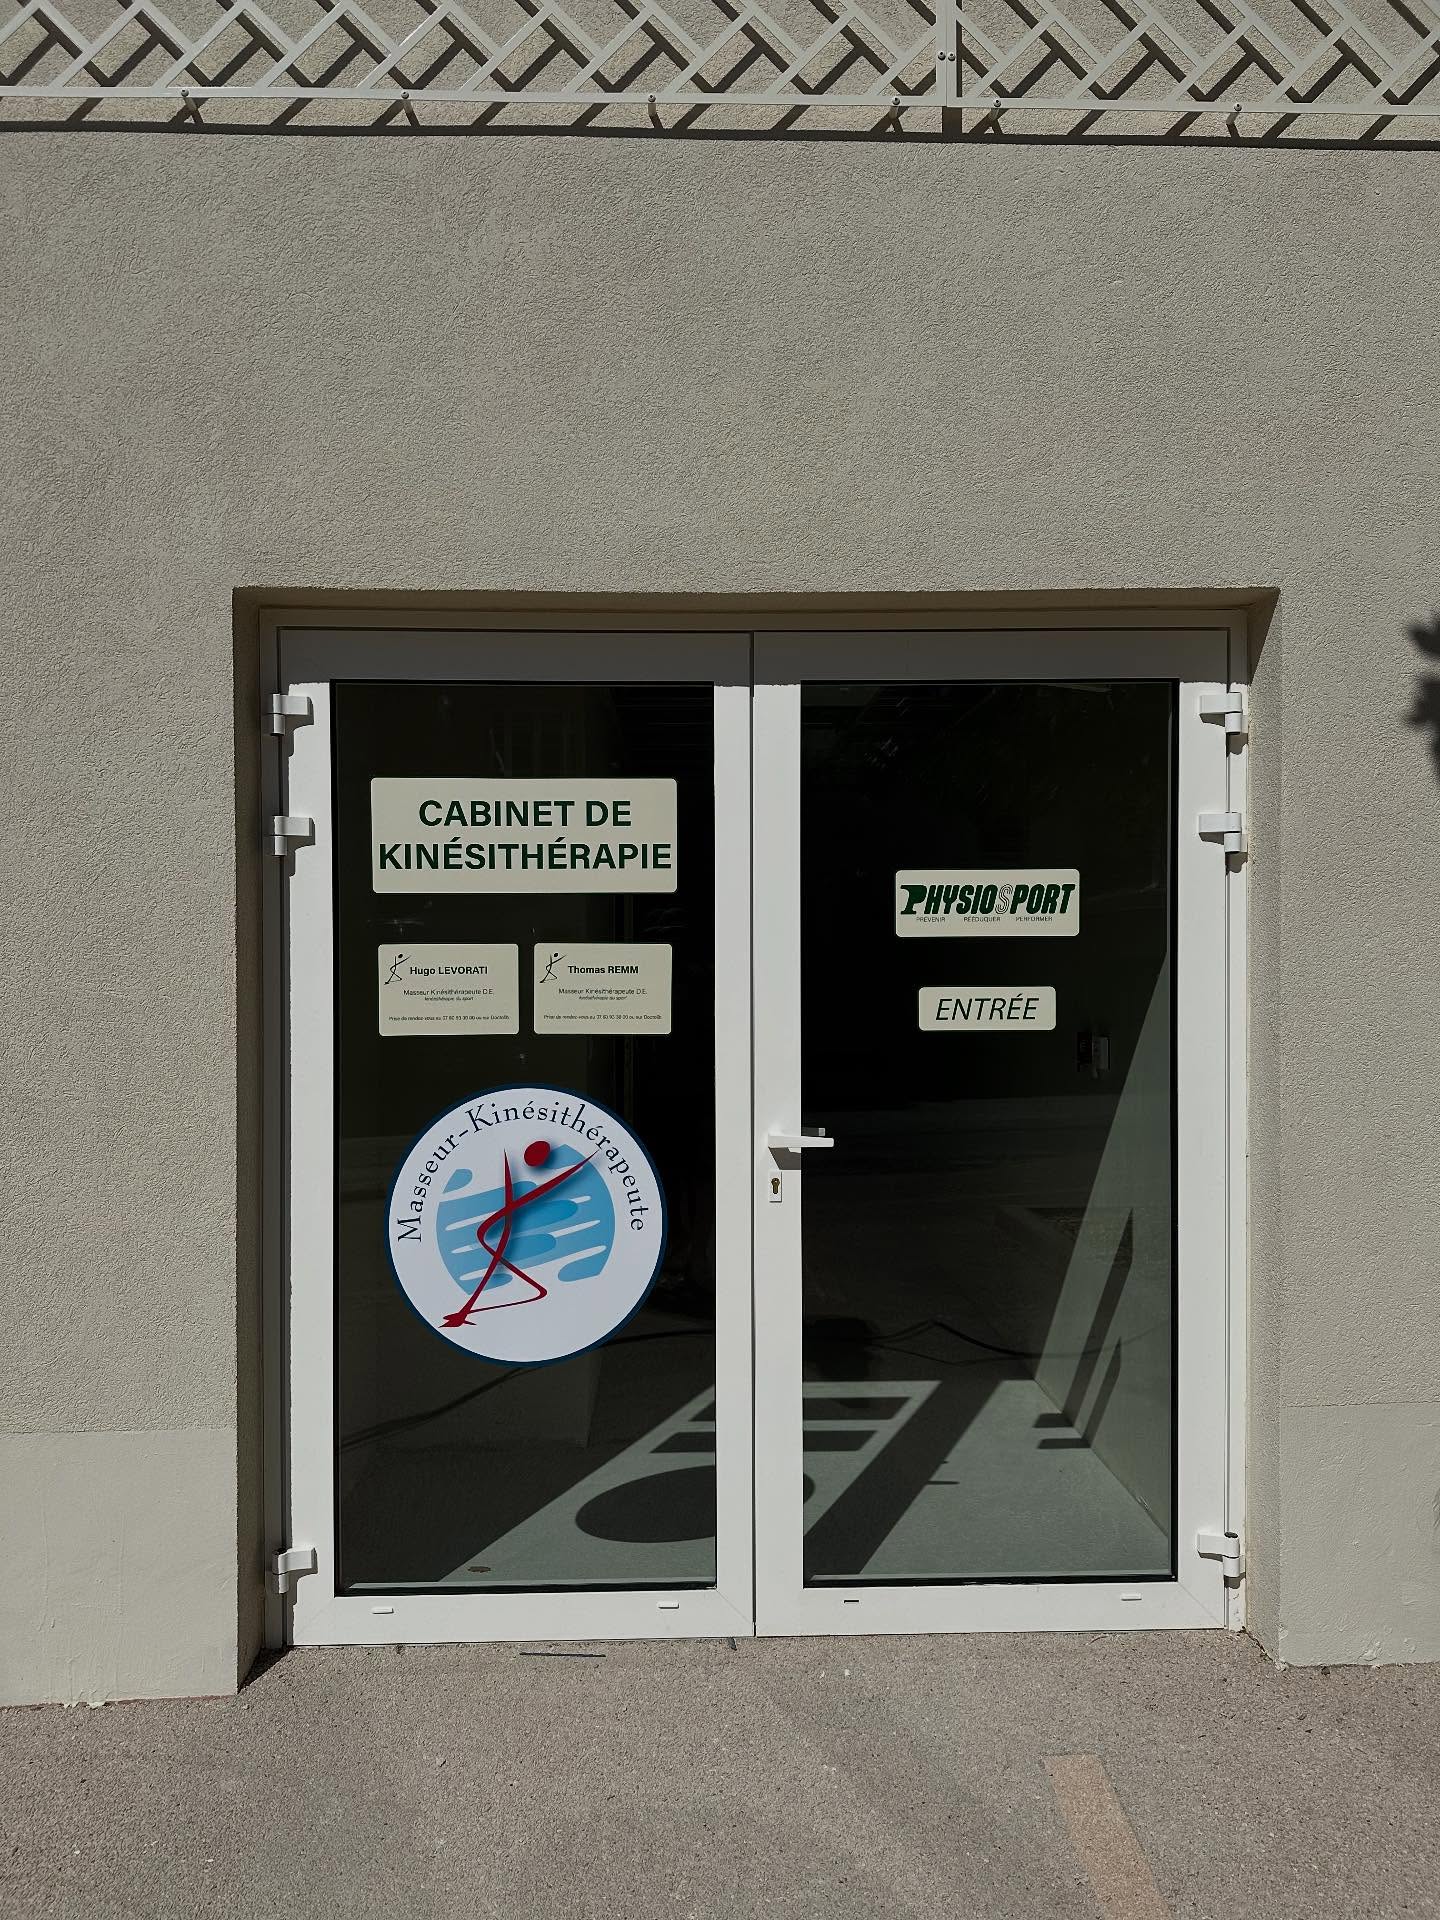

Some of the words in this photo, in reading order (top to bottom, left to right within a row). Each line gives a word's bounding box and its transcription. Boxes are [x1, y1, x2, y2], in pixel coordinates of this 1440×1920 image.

[418, 799, 575, 827] CABINET
[586, 800, 632, 827] DE
[379, 836, 672, 870] KINÉSITHÉRAPIE
[900, 883, 1076, 915] PHYSIOSPORT
[409, 966, 436, 977] Hugo
[438, 966, 488, 975] LEVORATI
[567, 965, 606, 974] Thomas
[607, 965, 639, 974] REMM
[935, 992, 1040, 1021] ENTRÉE
[397, 1100, 649, 1242] Masseur-Kinésithérapeute
